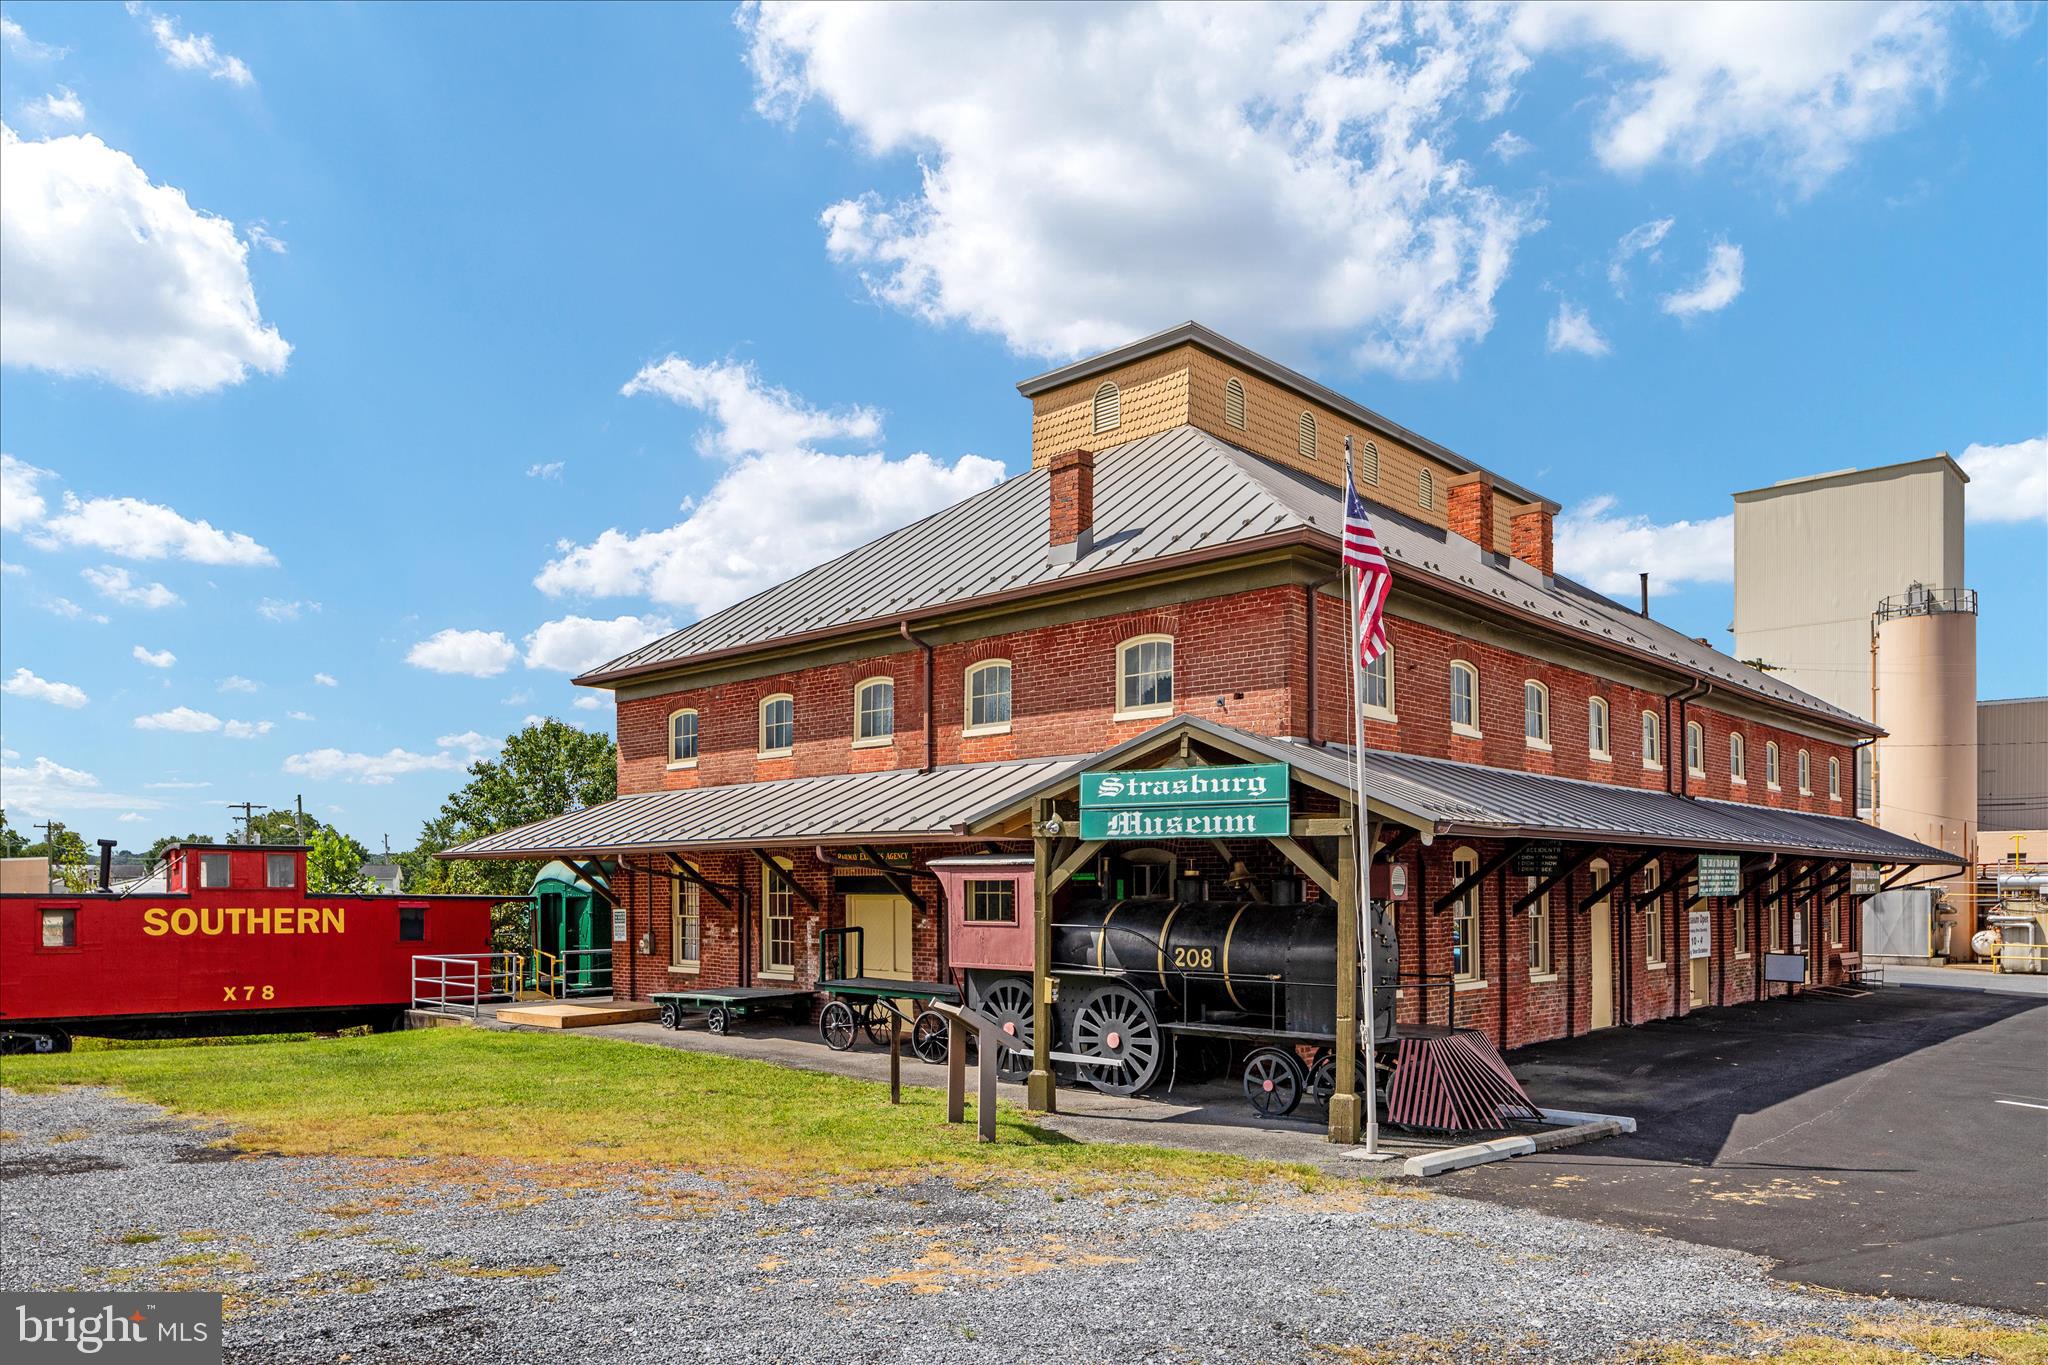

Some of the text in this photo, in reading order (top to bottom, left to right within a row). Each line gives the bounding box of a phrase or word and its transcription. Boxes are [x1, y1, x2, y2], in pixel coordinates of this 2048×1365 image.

[1096, 773, 1268, 798] Strasburg
[1105, 810, 1258, 837] Museum
[885, 852, 909, 861] AGENCY
[142, 907, 345, 936] SOUTHERN
[1174, 947, 1212, 968] 208
